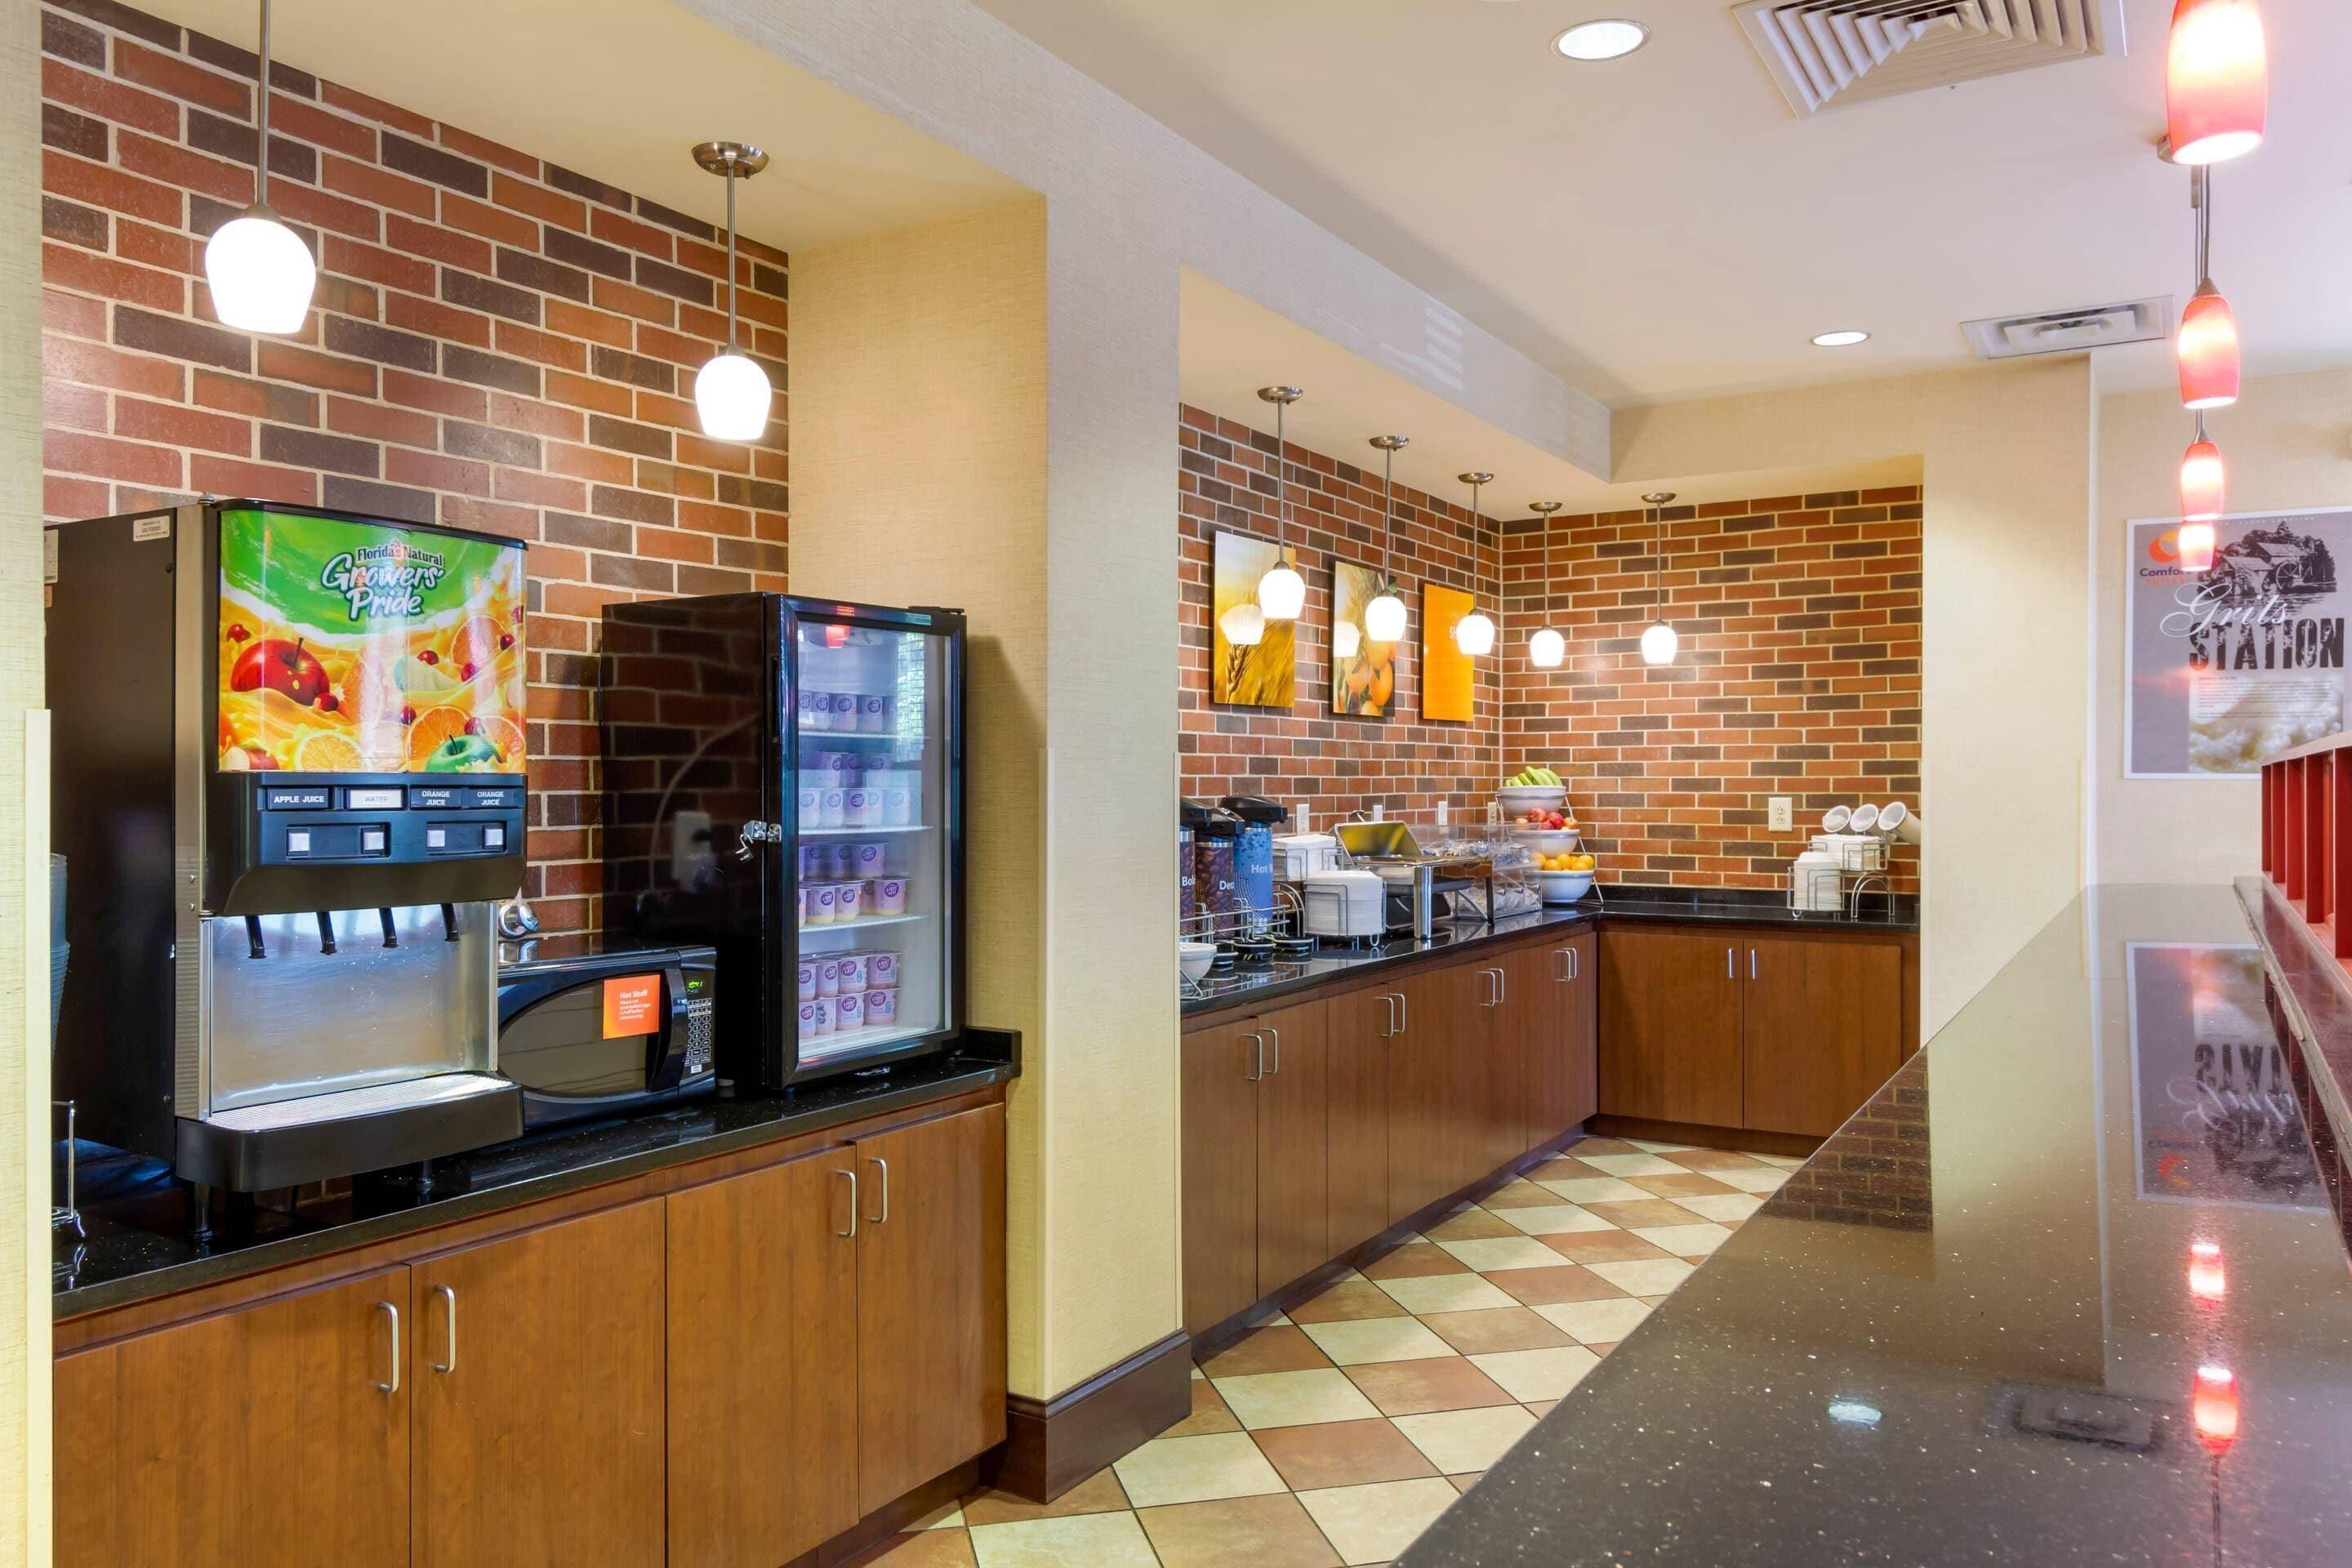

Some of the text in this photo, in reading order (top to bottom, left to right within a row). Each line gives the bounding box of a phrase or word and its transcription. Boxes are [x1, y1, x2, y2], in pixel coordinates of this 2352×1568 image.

[403, 546, 443, 566] Natural
[2140, 566, 2186, 577] Comfo
[345, 586, 423, 621] Pride
[2160, 582, 2287, 638] Grits
[2189, 617, 2344, 670] STATION
[1251, 864, 1267, 874] Hot
[633, 988, 648, 997] Stuff
